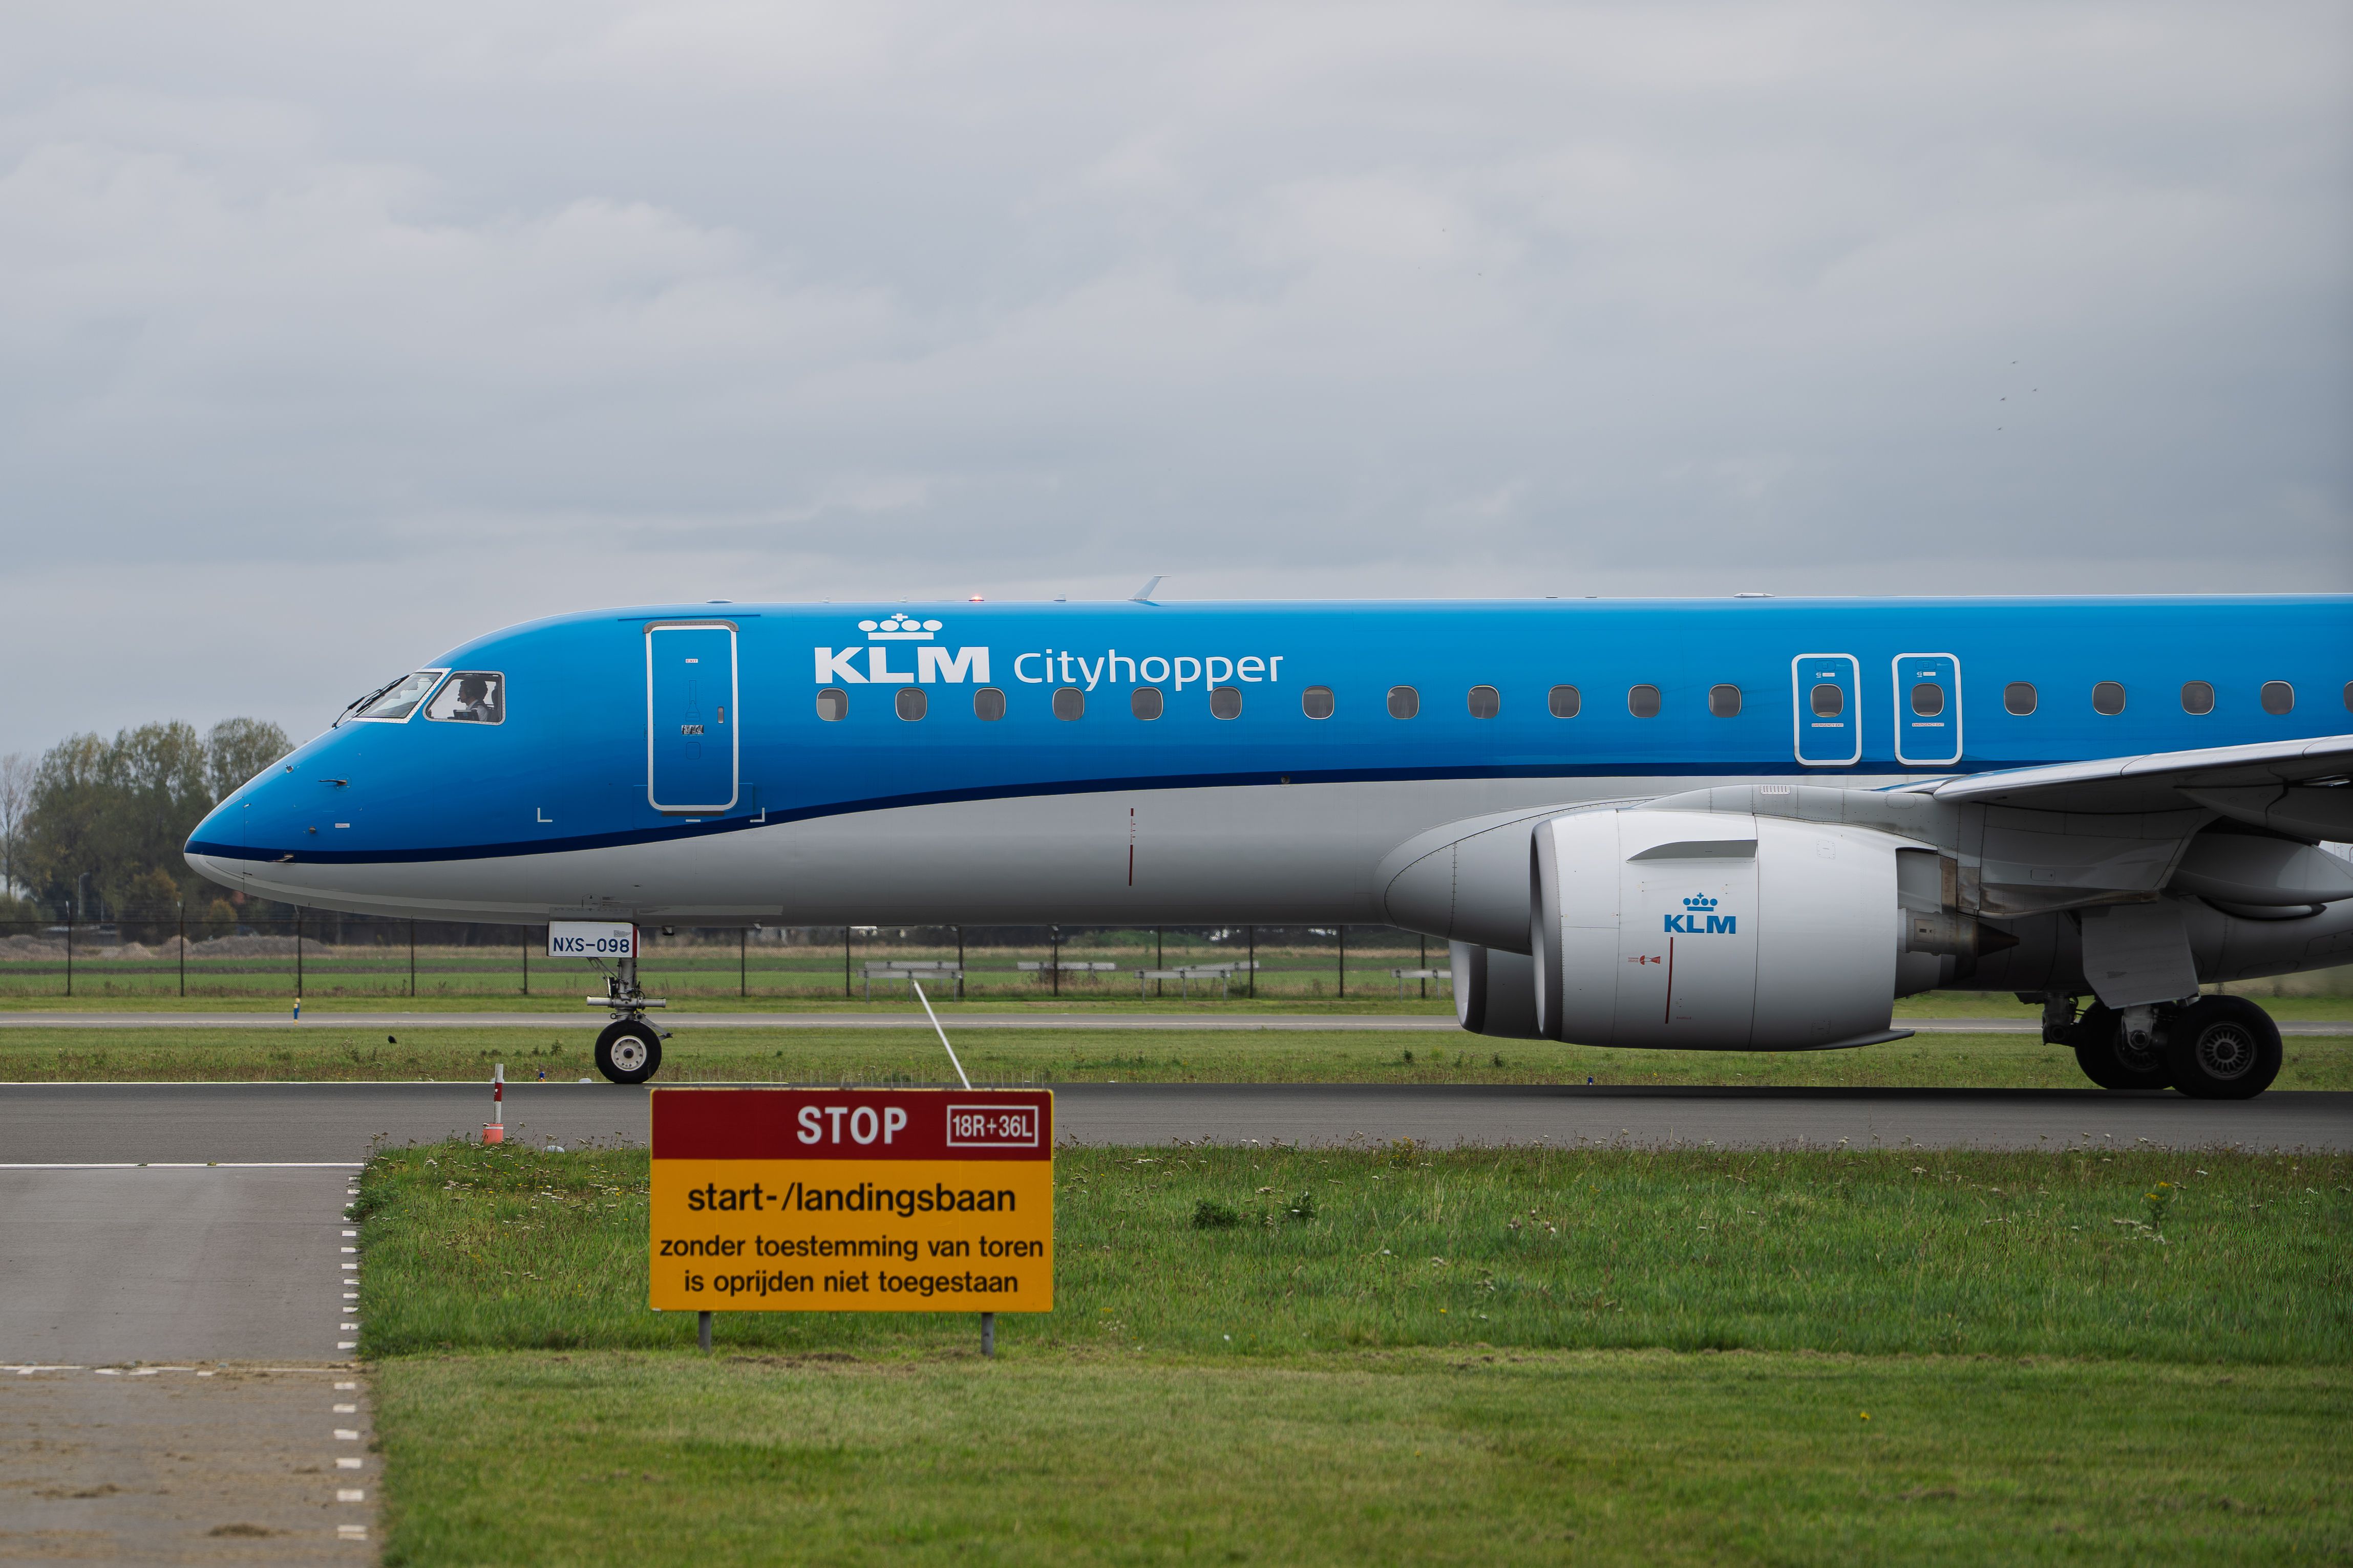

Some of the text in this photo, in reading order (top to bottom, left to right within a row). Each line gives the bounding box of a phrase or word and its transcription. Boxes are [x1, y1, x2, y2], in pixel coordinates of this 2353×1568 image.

[815, 647, 1283, 692] KLM Cityhopper
[1664, 914, 1736, 934] KLM
[553, 937, 629, 953] NXS-098
[797, 1106, 907, 1145] STOP
[952, 1115, 1033, 1137] 18R+36L
[660, 1235, 1043, 1261] zonder toestemming van toren
[685, 1270, 1017, 1296] is oprijden niet toegestaan
